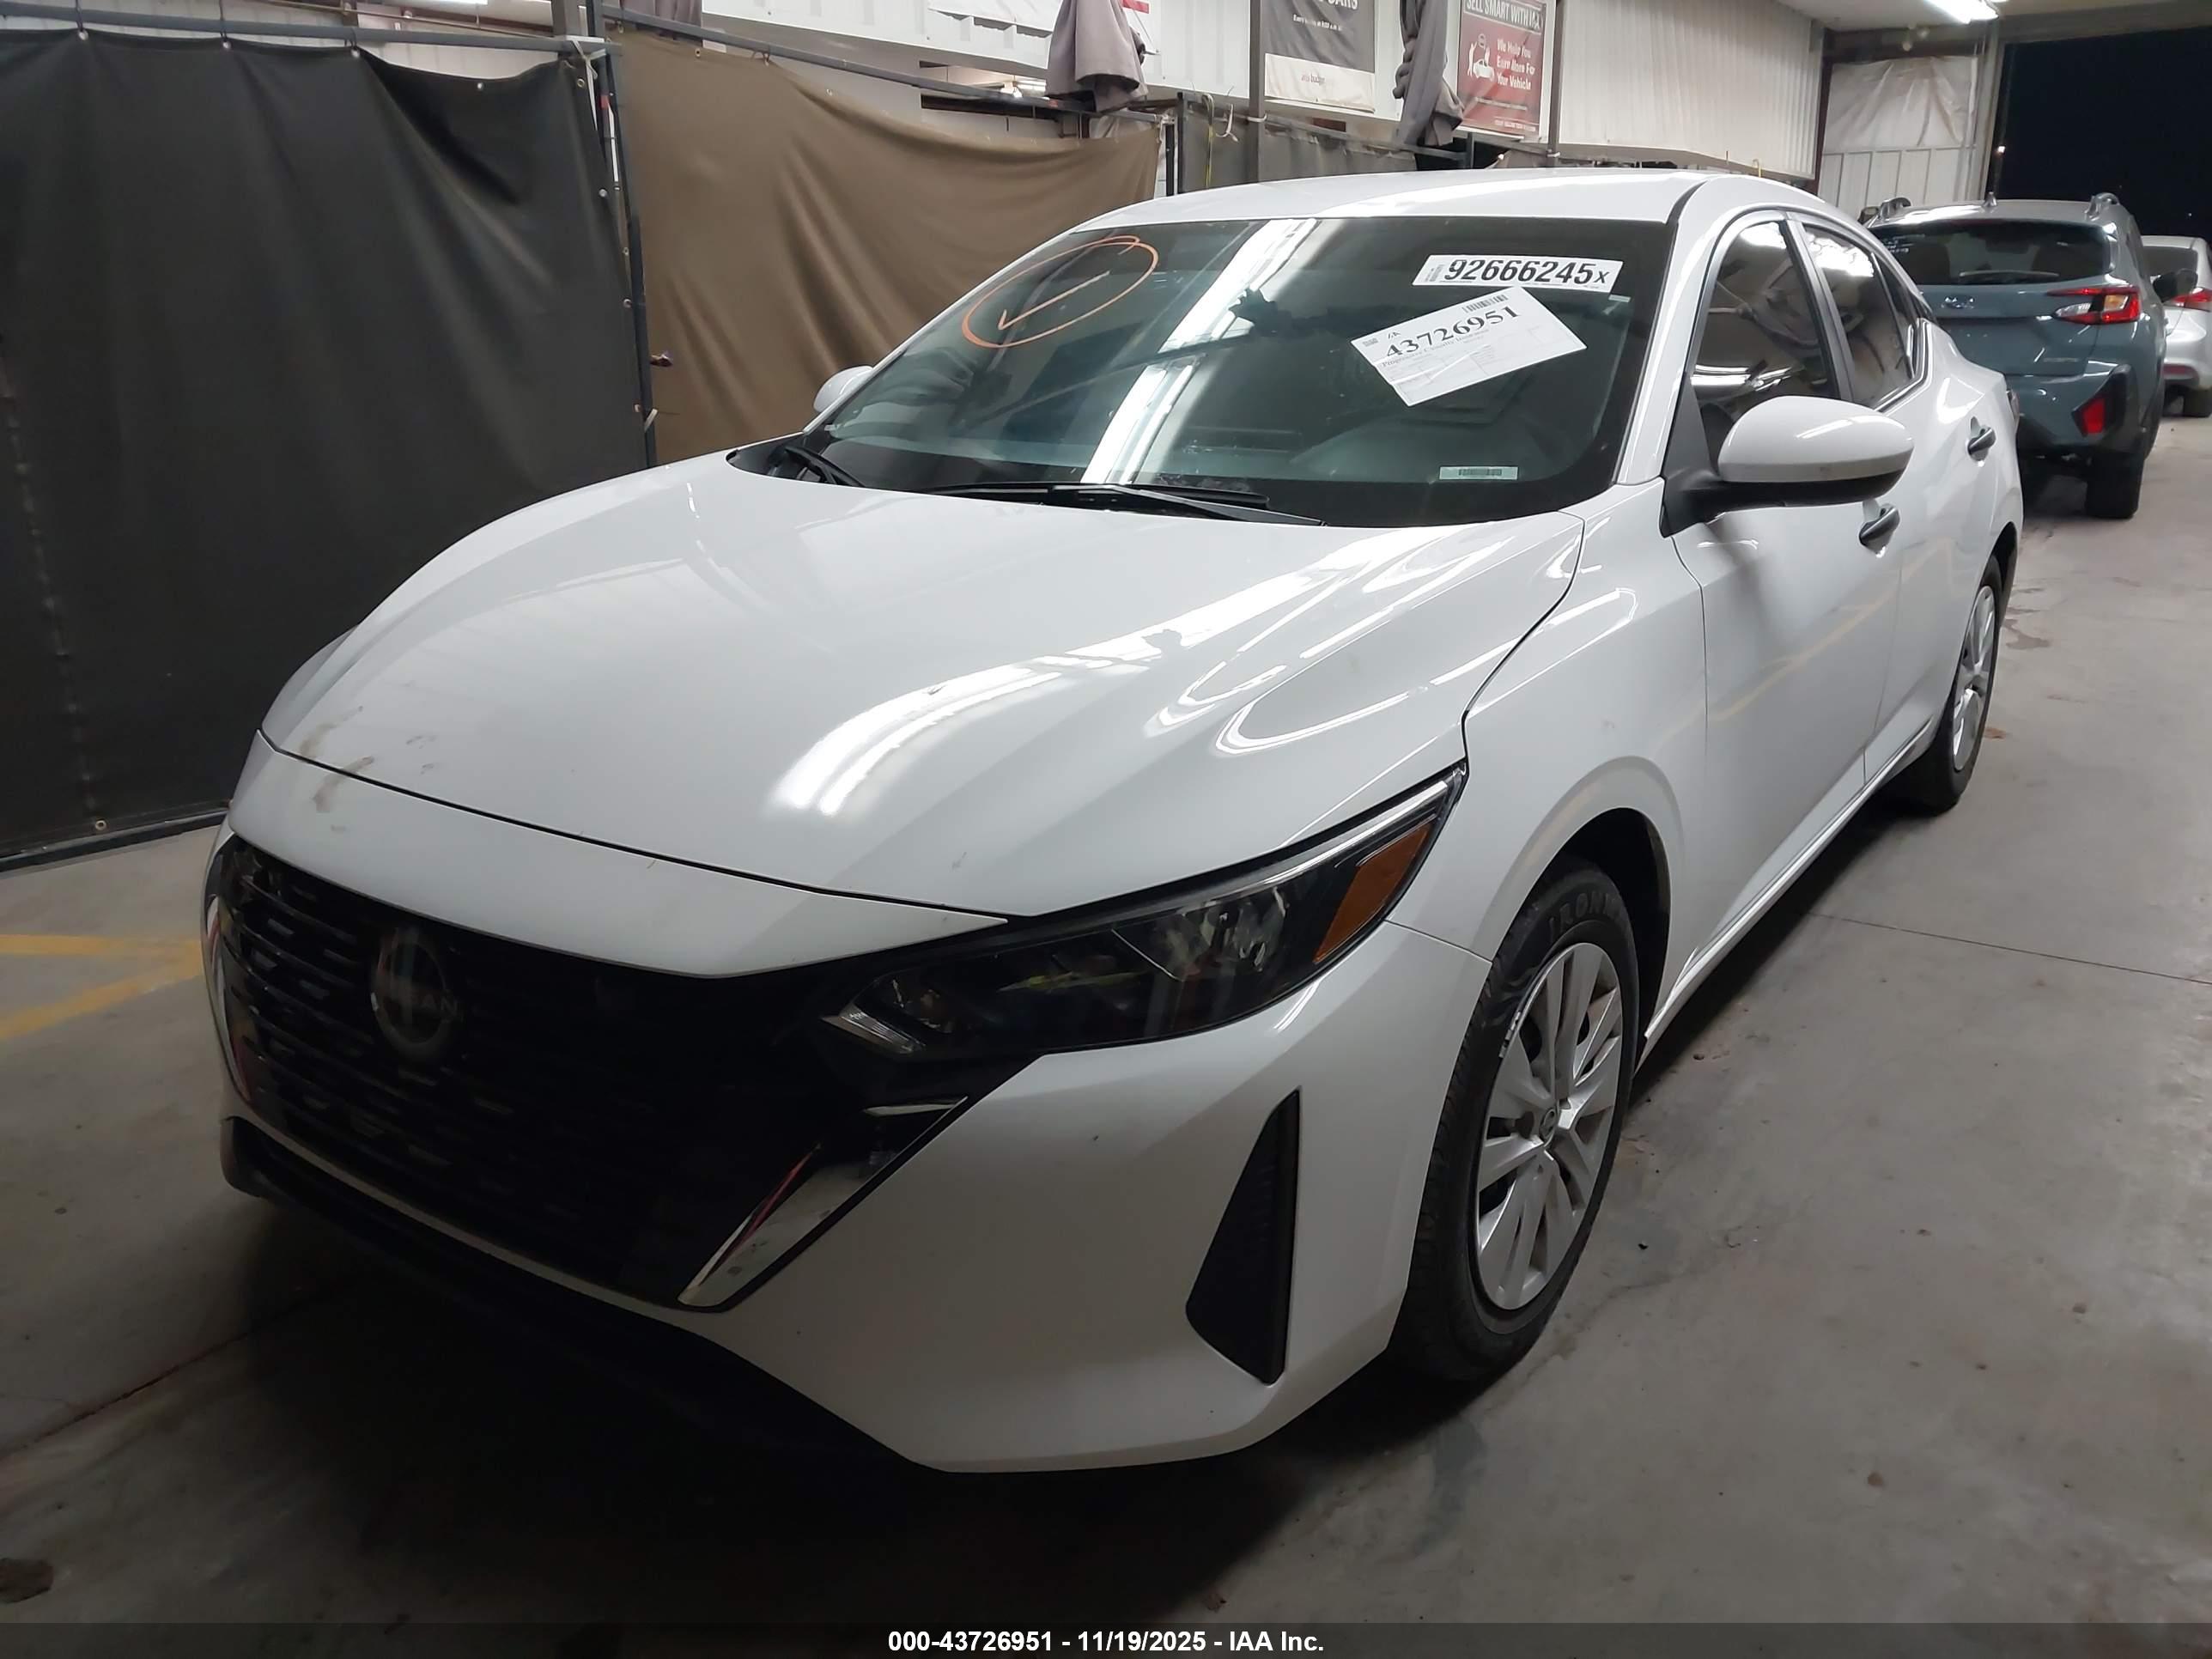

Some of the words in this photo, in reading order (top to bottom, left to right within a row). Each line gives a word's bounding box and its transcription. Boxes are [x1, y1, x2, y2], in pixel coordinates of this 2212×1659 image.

[1485, 0, 1510, 21] SMART
[1511, 5, 1528, 27] WITH
[1386, 306, 1521, 356] 43726951
